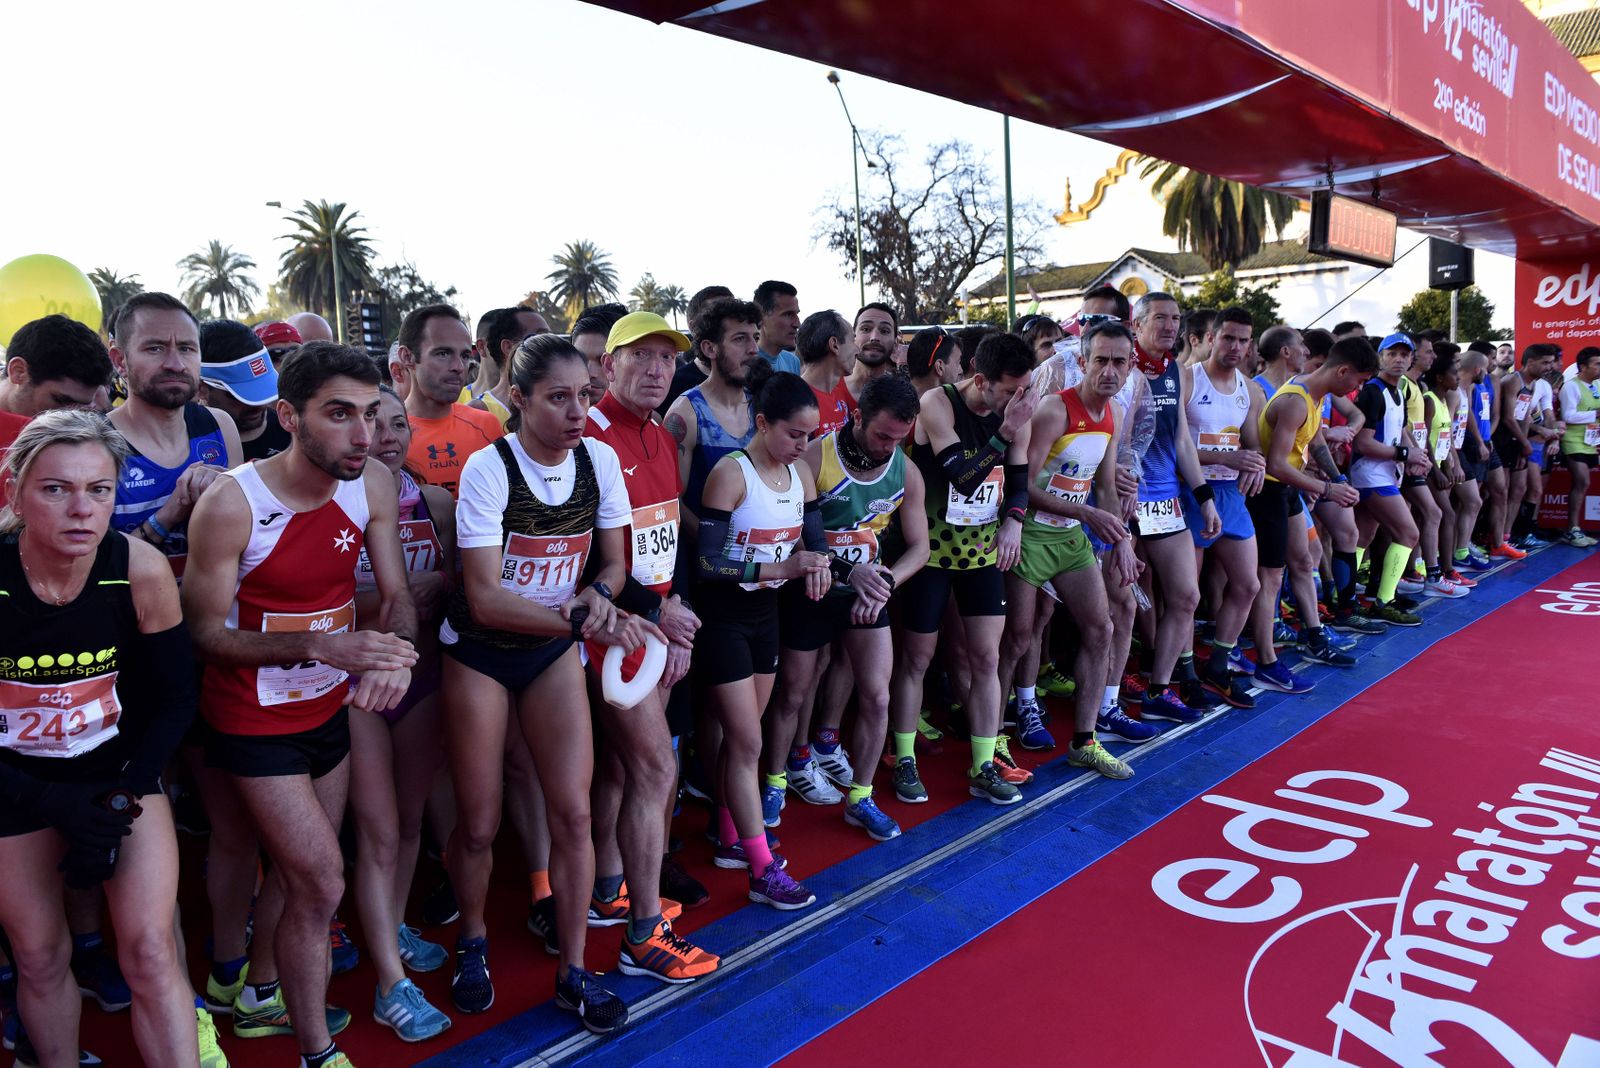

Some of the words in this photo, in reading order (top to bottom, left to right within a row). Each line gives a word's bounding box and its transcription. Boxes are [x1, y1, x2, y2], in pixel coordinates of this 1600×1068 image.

[1471, 43, 1509, 96] sevilla
[1454, 95, 1486, 137] edición
[1544, 71, 1567, 120] EDP
[1567, 92, 1598, 145] MEDIO
[1558, 142, 1573, 185] DE
[1532, 320, 1542, 329] la
[1545, 318, 1586, 329] energía
[1547, 330, 1564, 339] del
[429, 459, 459, 470] RUN
[125, 478, 155, 489] VIATOR
[1142, 498, 1174, 517] 1439
[400, 524, 414, 542] dp
[650, 524, 675, 556] 364
[835, 533, 853, 546] edp
[545, 540, 568, 556] edp
[517, 556, 577, 587] 9111
[309, 614, 334, 632] edp
[38, 689, 73, 709] edp
[17, 710, 89, 742] 243
[1151, 769, 1434, 923] edp
[1364, 782, 1600, 995] maratón
